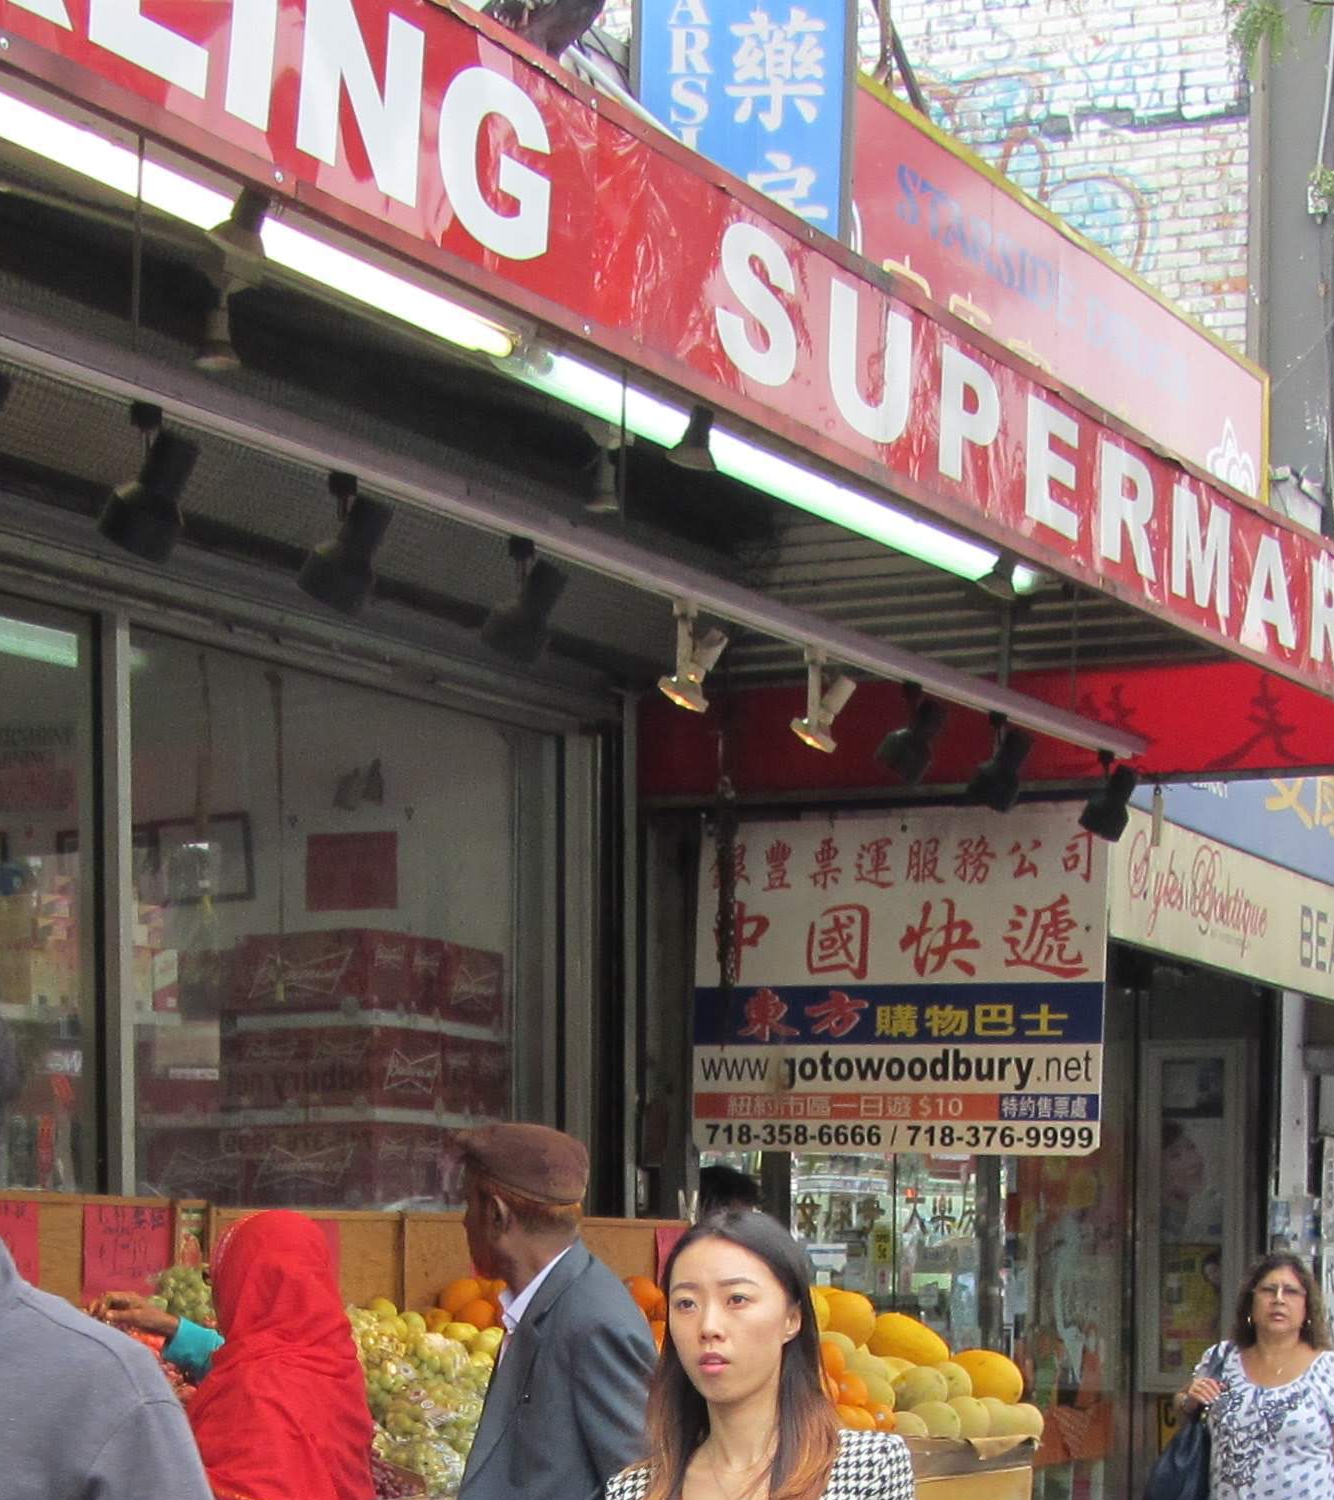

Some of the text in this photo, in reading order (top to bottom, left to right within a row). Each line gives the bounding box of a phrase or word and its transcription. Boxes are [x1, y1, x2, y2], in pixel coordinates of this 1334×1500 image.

[712, 893, 1090, 981] 中國快遞
[700, 1048, 1093, 1091] wwwgotowoodbury.net
[918, 1097, 964, 1118] $10
[705, 1123, 883, 1147] 718-358-6666
[907, 1124, 1095, 1150] 718-376-9999
